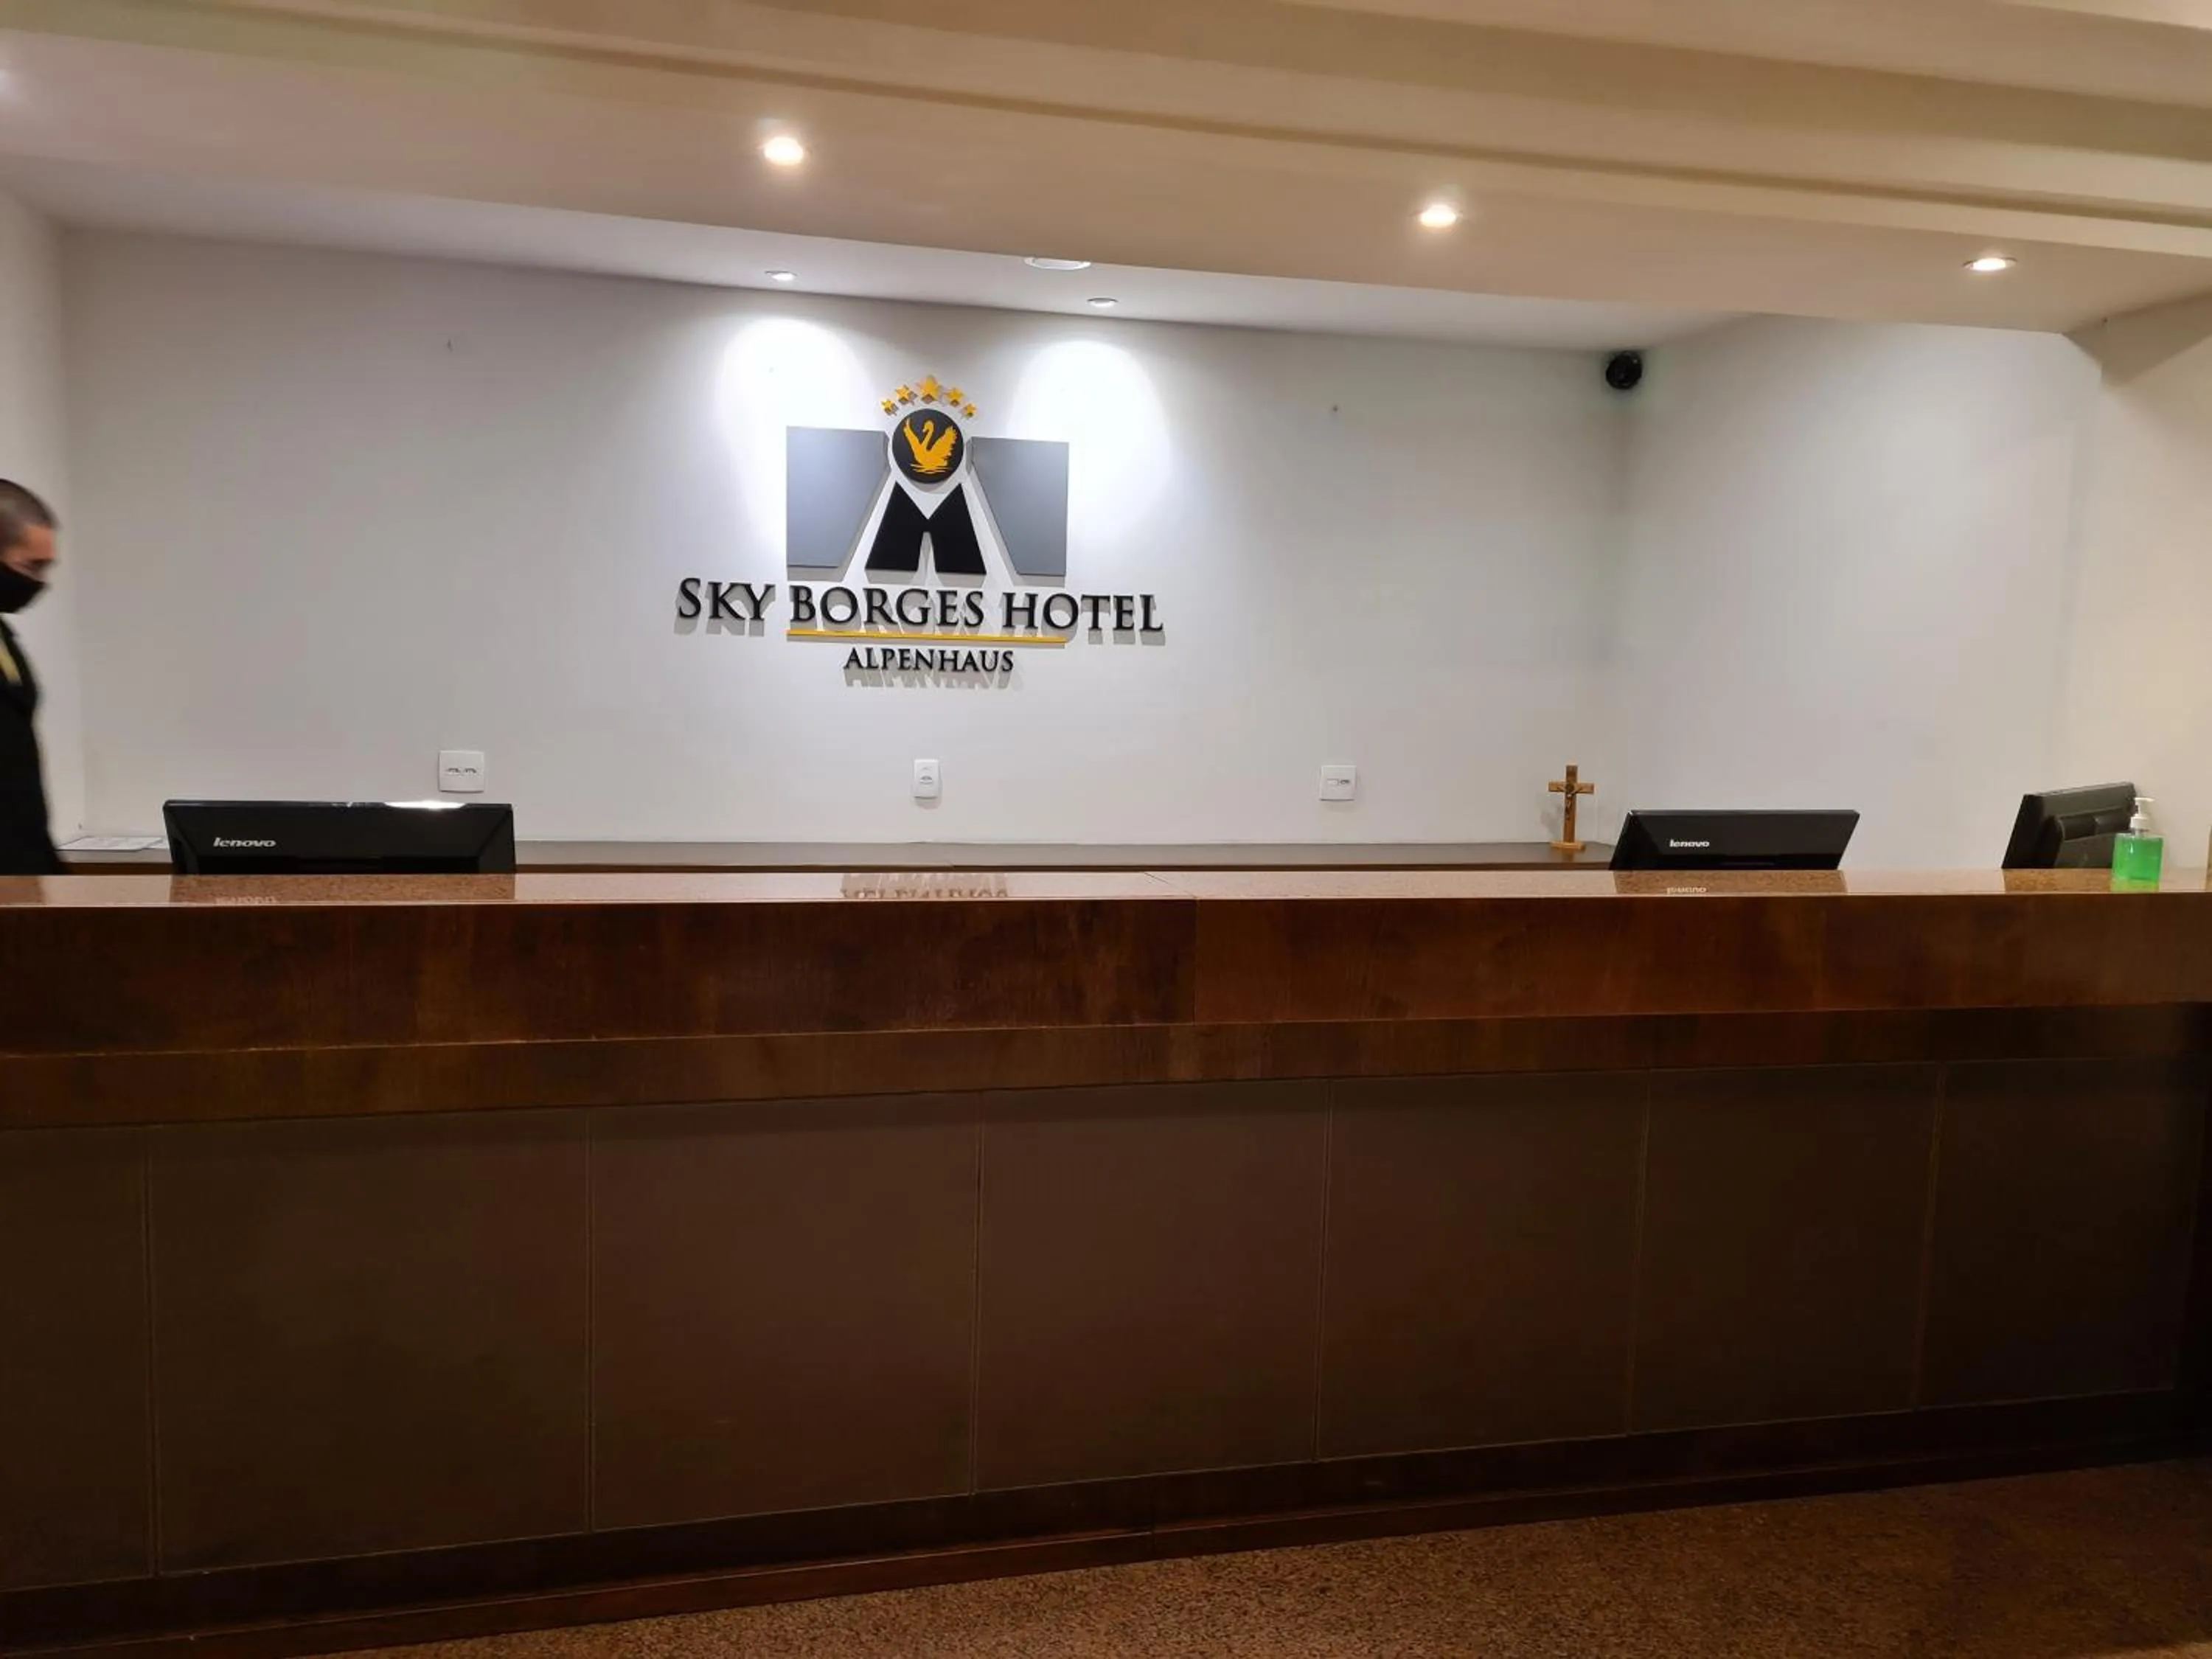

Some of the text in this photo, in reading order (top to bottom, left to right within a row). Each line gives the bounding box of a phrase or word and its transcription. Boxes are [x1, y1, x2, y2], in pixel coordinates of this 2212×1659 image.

[678, 577, 1164, 633] SKY BORGES HOTEL
[844, 647, 1015, 673] ALPENHAUS
[213, 837, 277, 847] lenovo
[1669, 839, 1710, 847] lenovo
